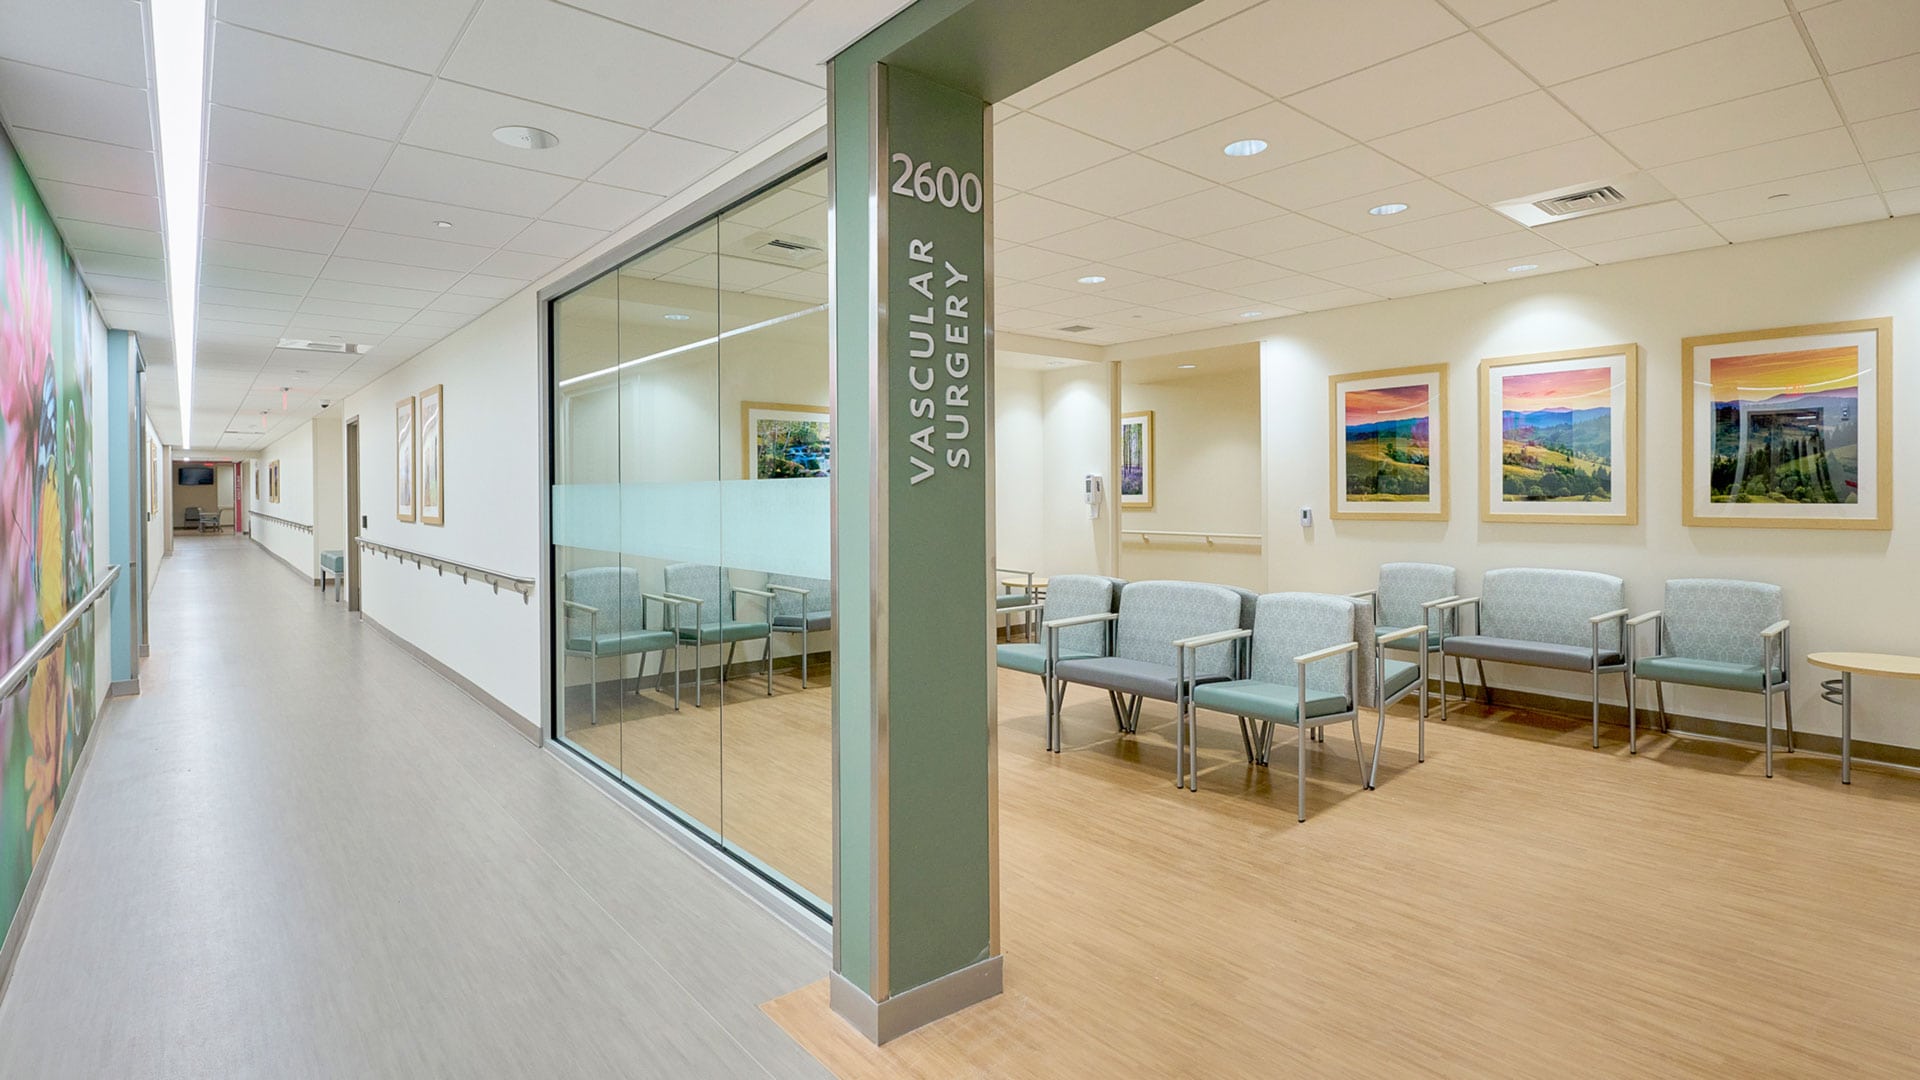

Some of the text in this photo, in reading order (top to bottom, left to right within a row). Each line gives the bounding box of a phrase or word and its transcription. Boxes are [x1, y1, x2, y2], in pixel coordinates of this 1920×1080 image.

[891, 153, 983, 213] 2600
[908, 238, 935, 485] VASCULAR
[944, 261, 970, 468] SURGERY
